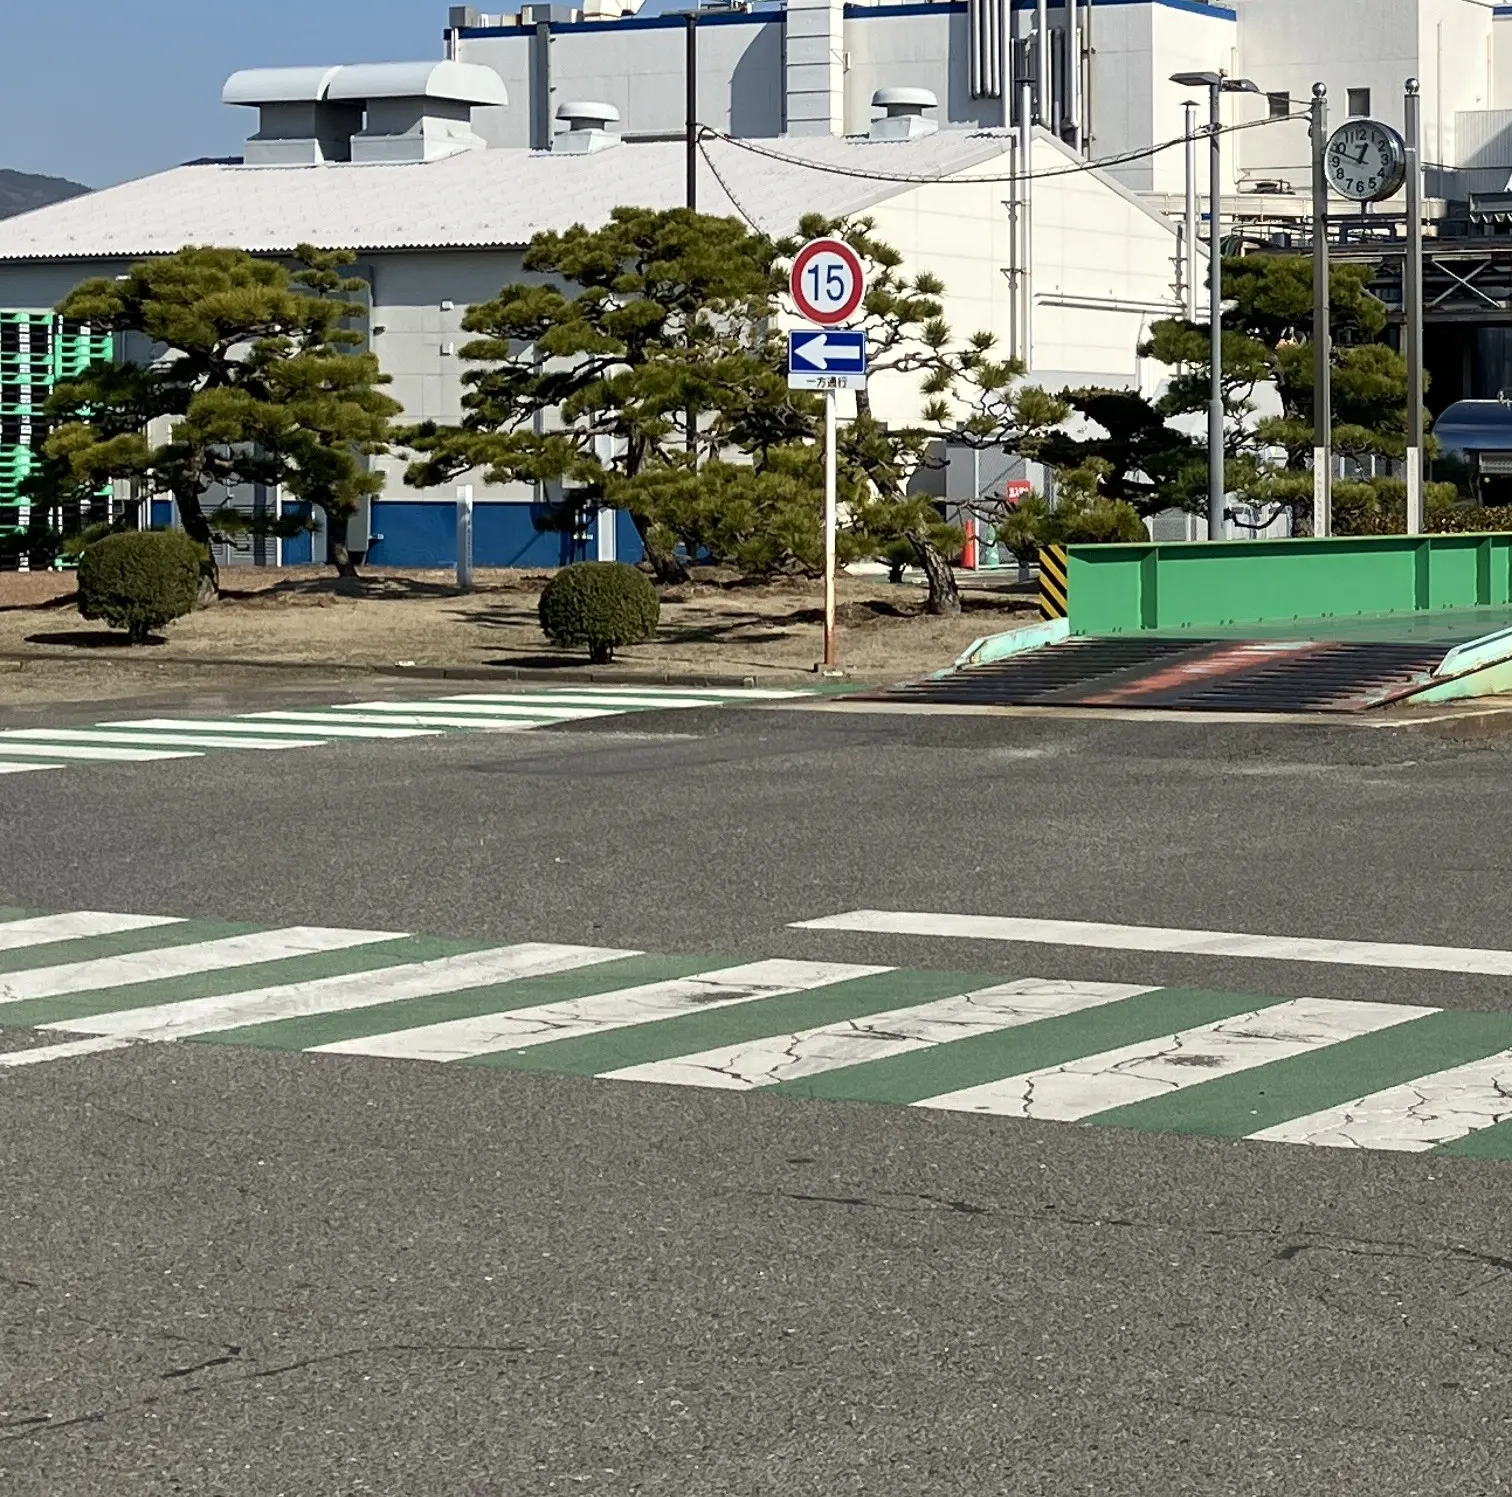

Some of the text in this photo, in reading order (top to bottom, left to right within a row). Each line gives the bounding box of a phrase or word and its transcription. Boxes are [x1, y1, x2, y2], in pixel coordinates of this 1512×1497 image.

[1355, 128, 1367, 141] 12
[1378, 140, 1386, 152] 2
[1331, 155, 1340, 168] 9
[1381, 154, 1389, 166] 3
[1336, 167, 1344, 180] 8
[1377, 168, 1385, 179] 4
[1345, 178, 1353, 190] 7
[1356, 181, 1364, 193] 6
[1368, 177, 1377, 189] 5
[807, 264, 845, 302] 15
